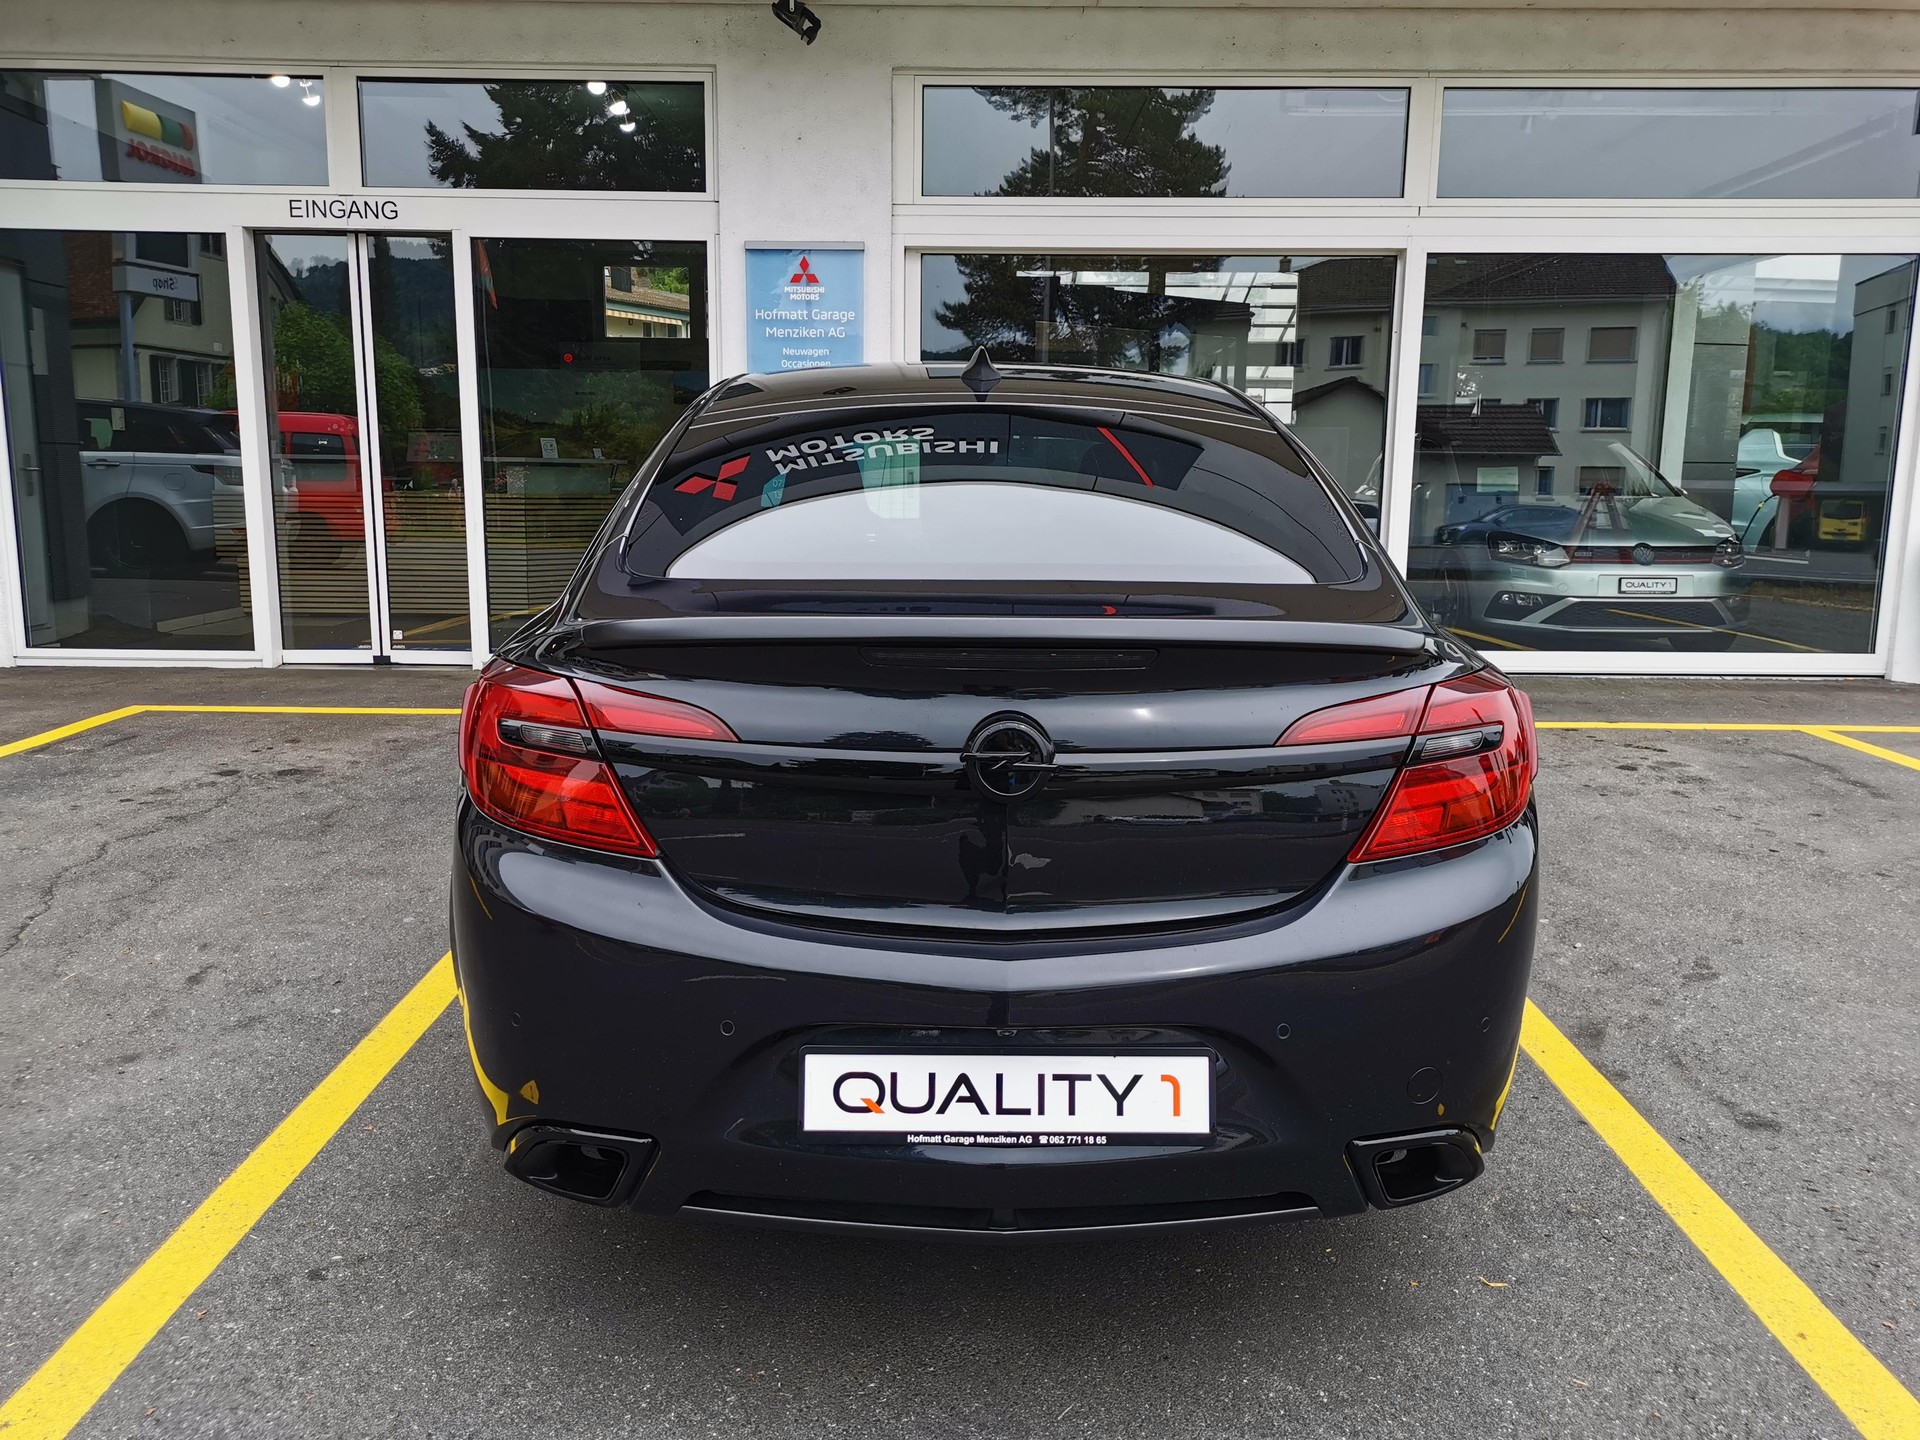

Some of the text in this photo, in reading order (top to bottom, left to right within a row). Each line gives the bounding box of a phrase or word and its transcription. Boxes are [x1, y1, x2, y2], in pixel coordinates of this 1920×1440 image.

[289, 199, 399, 220] EINGANG
[784, 286, 825, 294] MITSUBISHI
[789, 293, 820, 301] MOTORS
[755, 309, 856, 323] Hofmatt Garage
[765, 327, 846, 338] Menziken AG
[782, 348, 830, 357] Neuwagen
[1625, 581, 1667, 589] QUALITY
[832, 1071, 1181, 1117] QUALITY 1
[907, 1134, 1107, 1145] Hofmatt Garage Menziken AG 062 771 18 65
